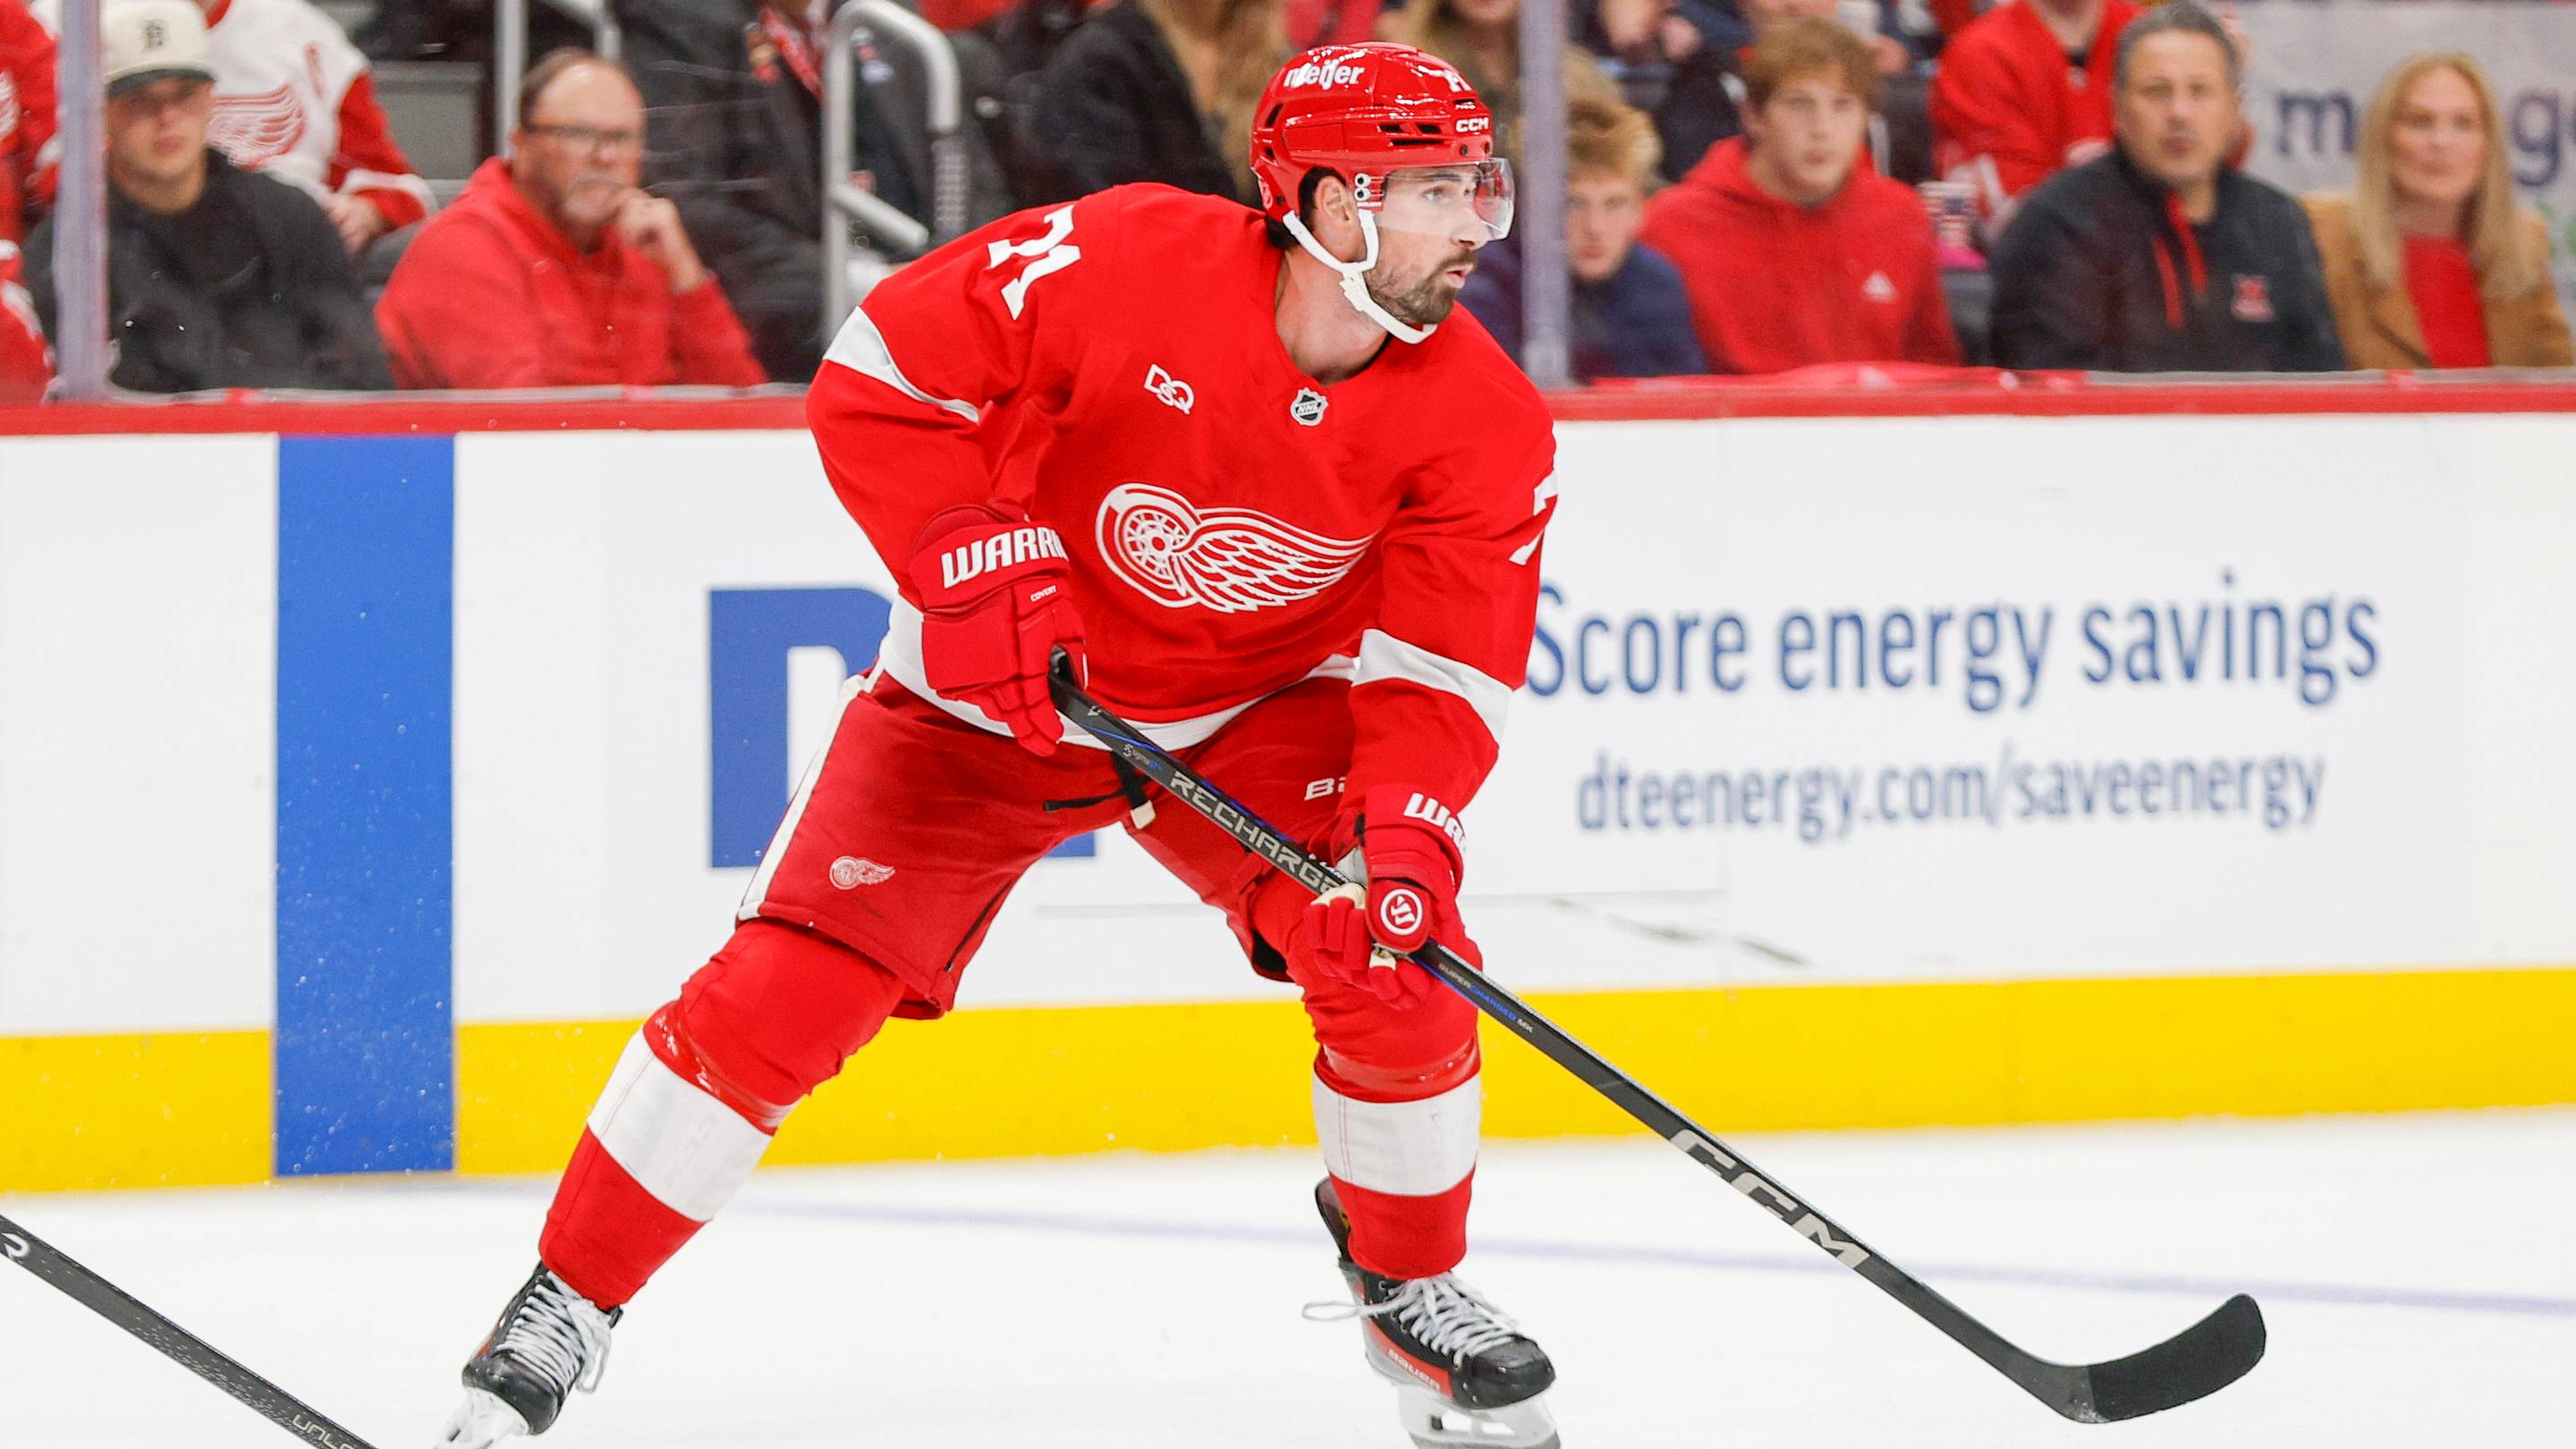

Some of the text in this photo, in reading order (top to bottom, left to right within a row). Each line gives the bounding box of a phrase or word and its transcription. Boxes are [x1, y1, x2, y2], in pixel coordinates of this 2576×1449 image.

[1455, 117, 1489, 133] CCM
[1528, 572, 2380, 715] Score energy savings
[1577, 746, 2326, 845] dteenergy.com/saveenergy
[1669, 1129, 1871, 1269] CCM
